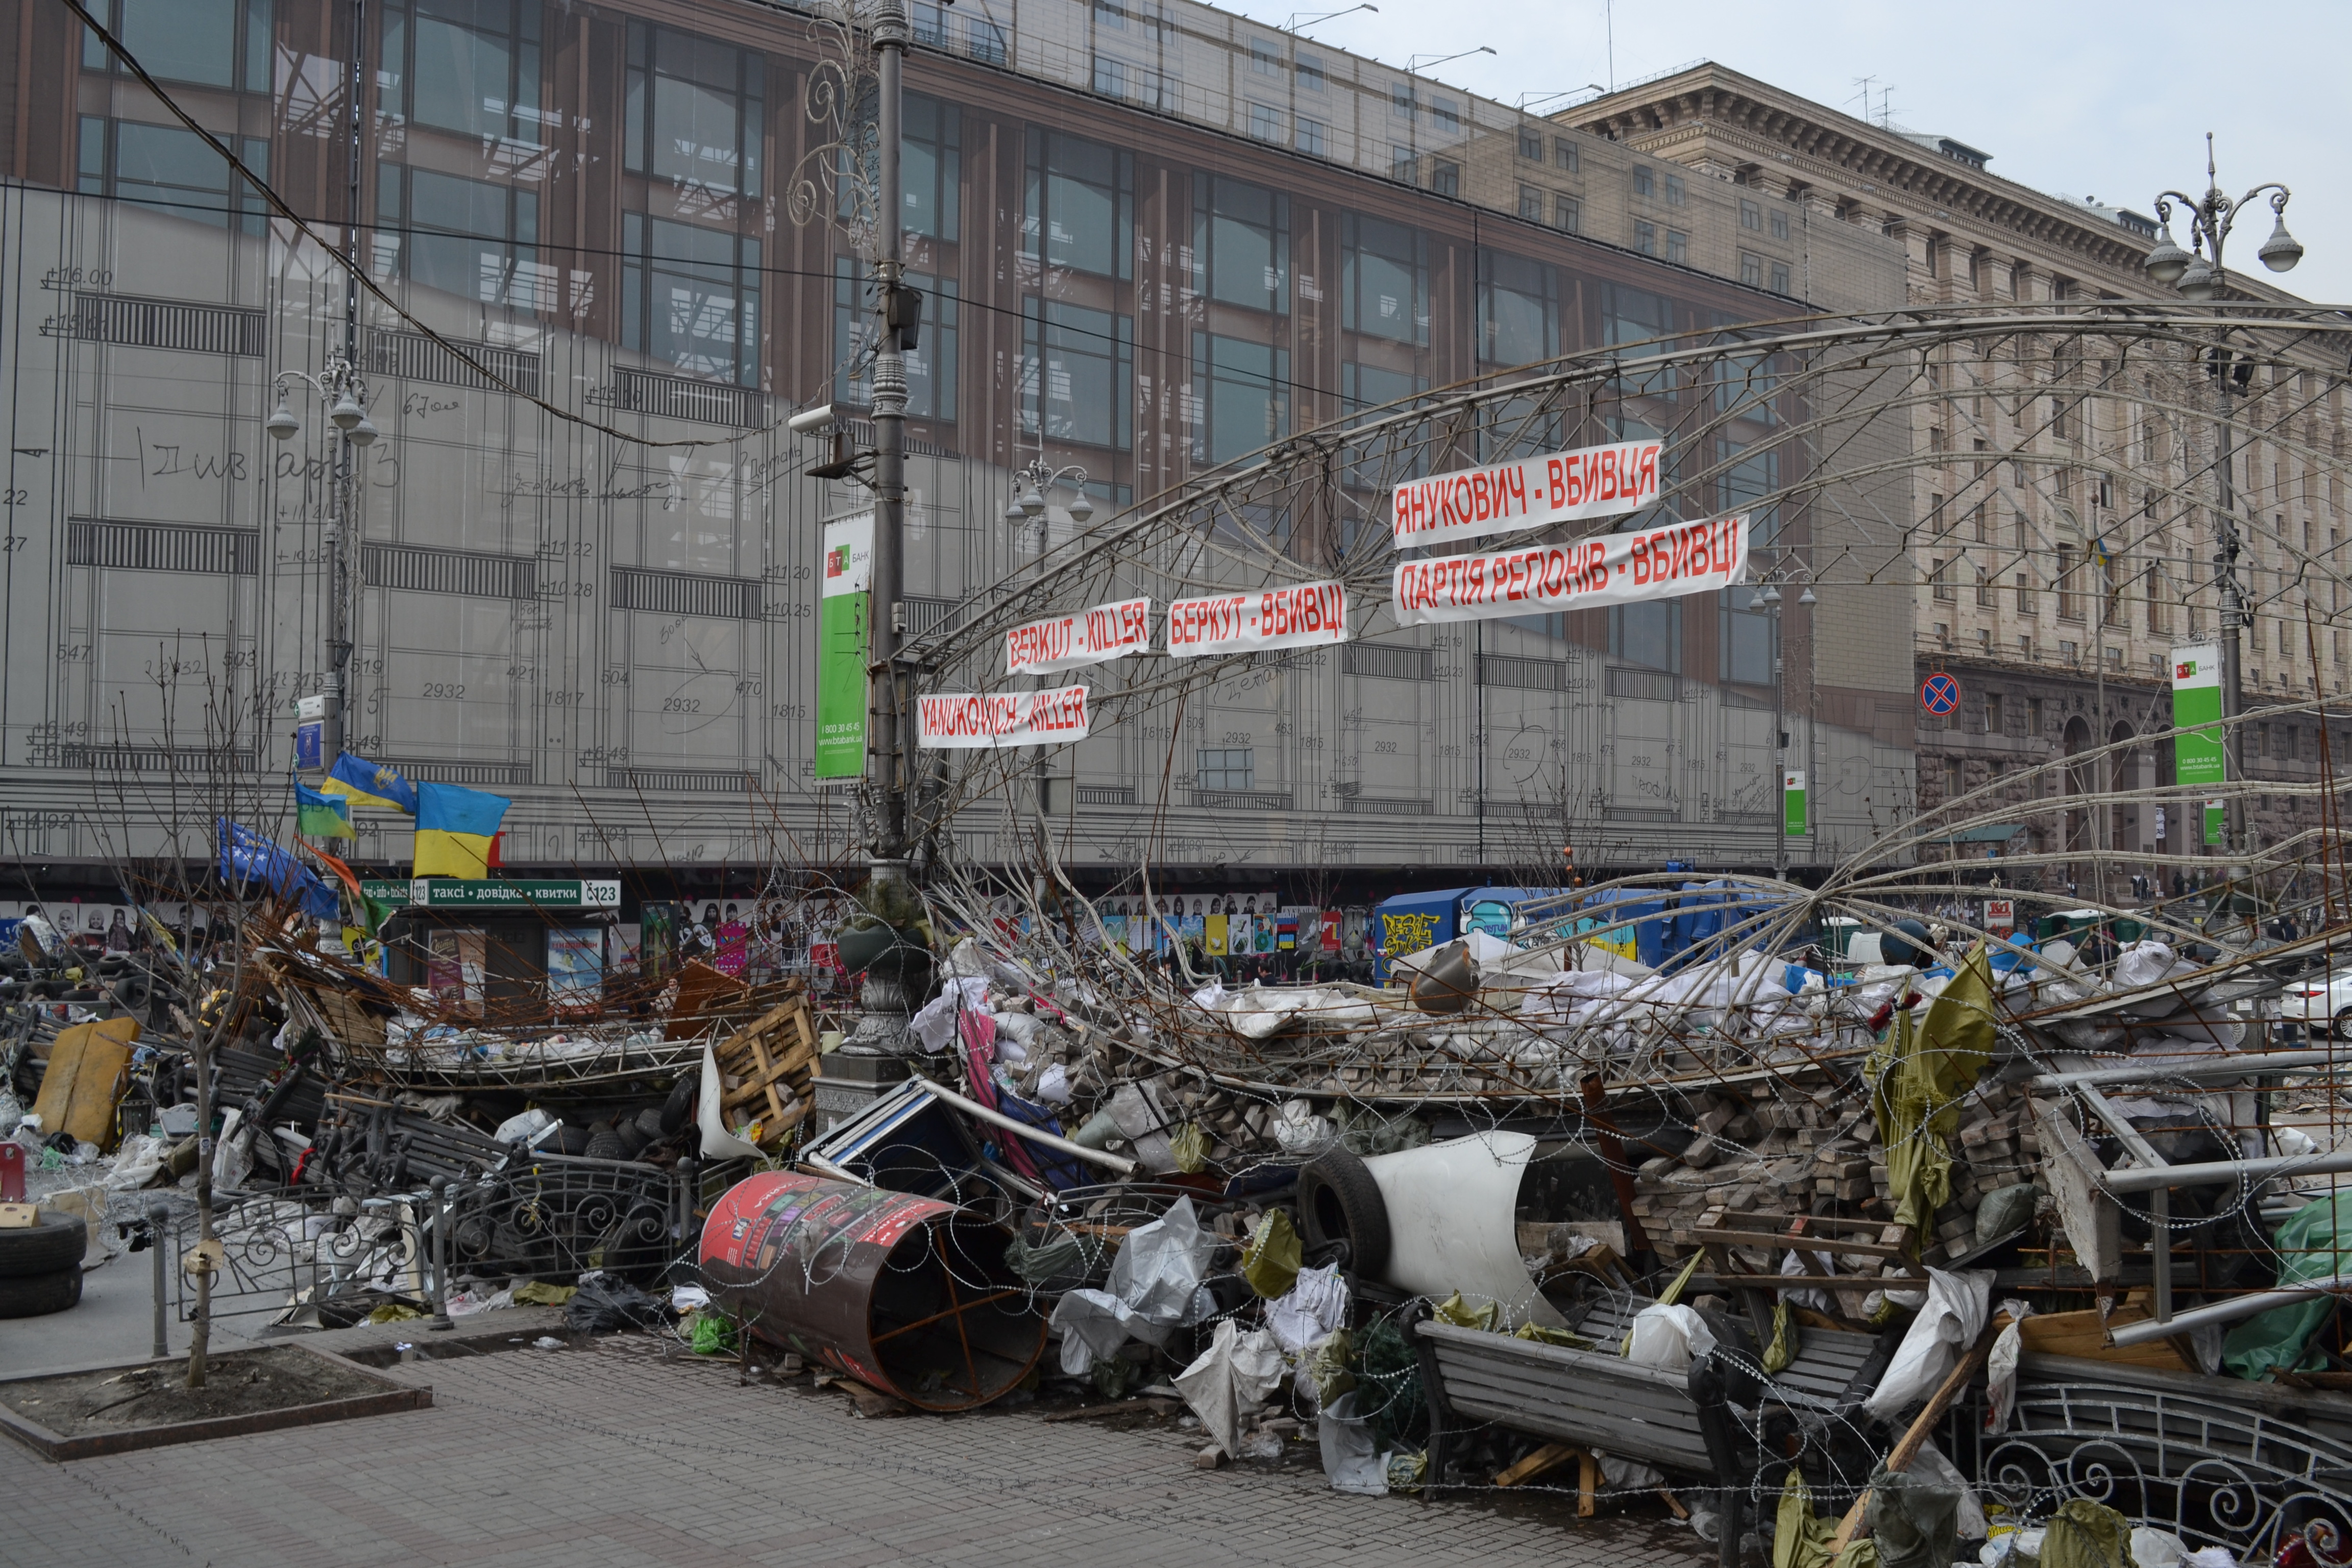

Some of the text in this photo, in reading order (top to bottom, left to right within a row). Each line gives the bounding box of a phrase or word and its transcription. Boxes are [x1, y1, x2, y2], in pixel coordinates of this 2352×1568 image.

[48, 267, 113, 286] +16.00
[1395, 465, 1527, 535] ЯНУКОВИЧ
[1548, 445, 1659, 509] ВБИВЦЯ
[540, 540, 593, 557] +11.22
[829, 550, 869, 568] БТА БАНК
[1399, 558, 1486, 610] ПАРТІЯ
[1491, 542, 1608, 602] РЕГІОНІВ
[1632, 519, 1738, 585] ВБИВЦІ
[764, 566, 811, 580] +11.20
[540, 580, 593, 598] +10.28
[764, 603, 811, 617] +10.25
[1171, 597, 1246, 644] БЕРКУТ
[1261, 584, 1344, 637] ВБИВЦІ
[1009, 618, 1073, 668] BERKUT
[1086, 601, 1148, 653] KILLER
[56, 645, 92, 660] 547
[223, 651, 256, 667] 503
[1294, 653, 1327, 666] +10.22
[350, 658, 383, 675] 519
[506, 666, 535, 679] 421
[1433, 666, 1463, 678] +10.23
[2177, 666, 2196, 674] БТА
[601, 670, 629, 685] 504
[1566, 678, 1596, 689] +10.20
[423, 682, 466, 700] 2932
[736, 681, 763, 695] 470
[1684, 689, 1709, 699] +10.20
[546, 691, 584, 706] 1817
[663, 698, 701, 713] 2932
[771, 703, 806, 719] 1815
[920, 696, 1016, 737] YANUKOVICH
[1030, 688, 1087, 732] KILLER
[37, 720, 88, 737] +6.49
[824, 723, 837, 733] 800
[838, 723, 846, 732] 30
[846, 722, 853, 732] 45
[853, 722, 860, 731] 45
[1186, 717, 1205, 729] 509
[1275, 722, 1293, 735] 463
[1142, 726, 1171, 740] 1815
[1226, 731, 1251, 744] 2932
[1300, 736, 1324, 749] 1815
[1375, 741, 1397, 752] 2932
[1550, 740, 1566, 749] 466
[1439, 745, 1461, 756] 1815
[1509, 748, 1531, 759] 2932
[1600, 745, 1615, 755] 475
[1572, 752, 1592, 763] 1815
[1631, 756, 1651, 767] 2932
[1687, 760, 1705, 769] 1815
[1739, 763, 1755, 772] 2932
[364, 887, 373, 898] taxi
[377, 886, 387, 898] info
[390, 885, 408, 898] tickets
[433, 885, 465, 898] таксі
[476, 885, 523, 900] довідка
[535, 887, 577, 899] квитки
